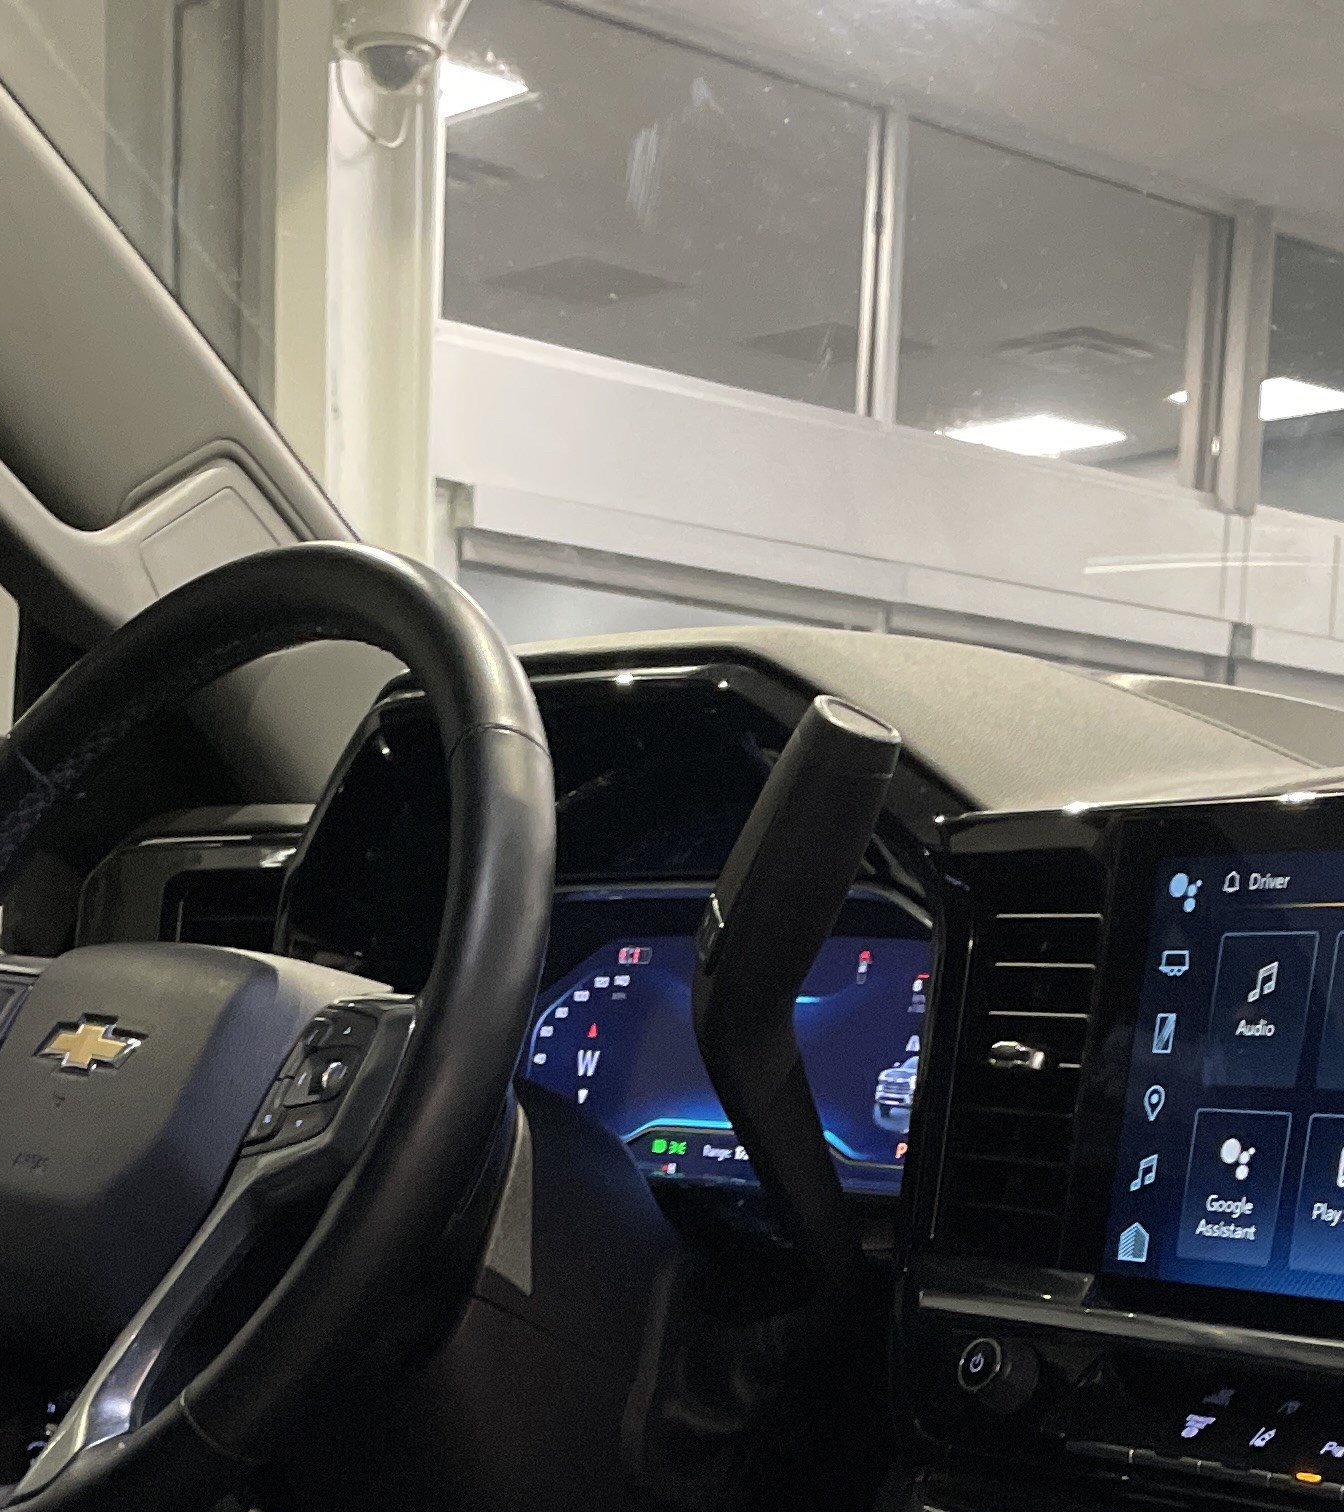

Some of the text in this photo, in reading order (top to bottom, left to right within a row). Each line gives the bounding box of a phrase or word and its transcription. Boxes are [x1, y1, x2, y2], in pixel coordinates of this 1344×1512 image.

[1248, 871, 1291, 891] Driver
[1234, 1018, 1276, 1037] Audio
[577, 1049, 601, 1077] W
[1205, 1195, 1254, 1219] Google
[1311, 1202, 1344, 1227] Play
[1194, 1218, 1257, 1241] Assistant
